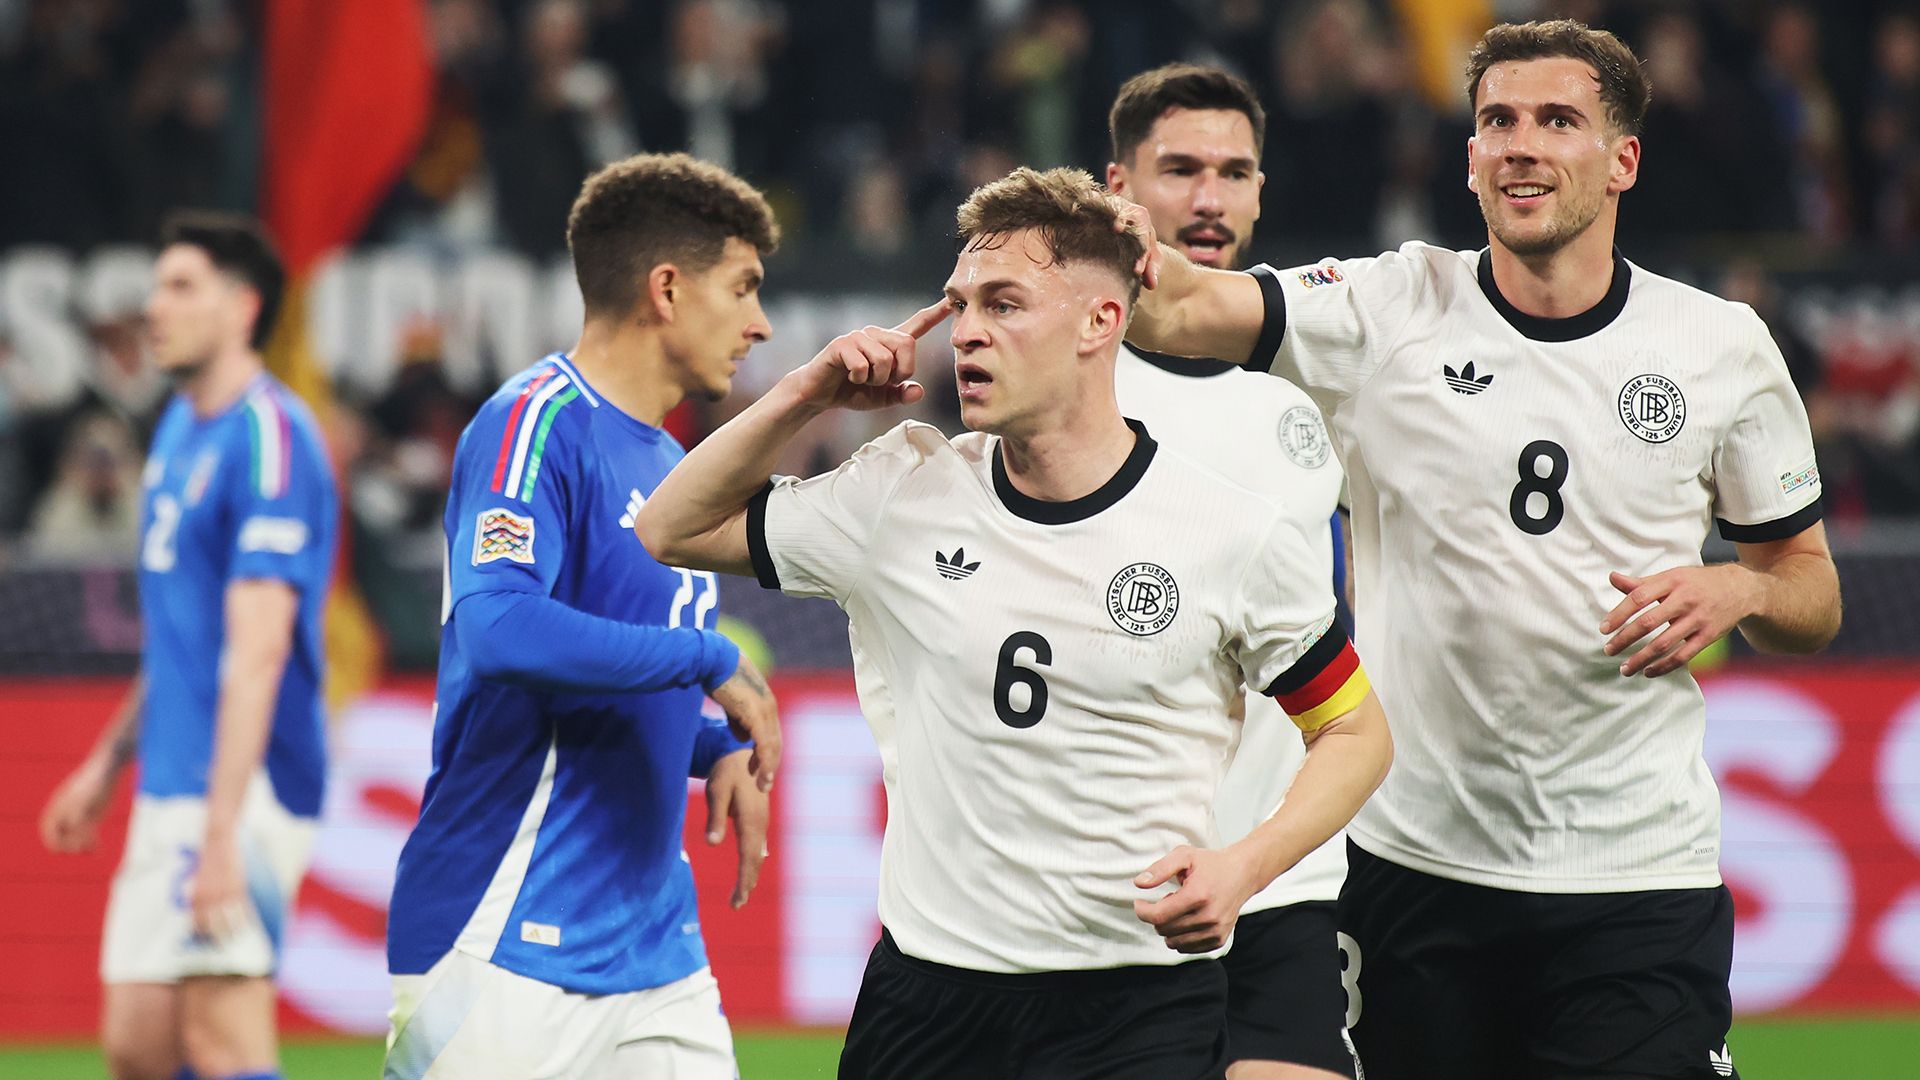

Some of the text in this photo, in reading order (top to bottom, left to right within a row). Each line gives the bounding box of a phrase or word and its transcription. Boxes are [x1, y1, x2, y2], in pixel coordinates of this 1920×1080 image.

[1623, 379, 1642, 430] DEUTSCHER
[1645, 430, 1659, 439] 125
[1510, 440, 1568, 535] 8
[1111, 567, 1137, 621] DEUTSCHER
[1130, 622, 1145, 632] 125
[994, 631, 1052, 728] 6
